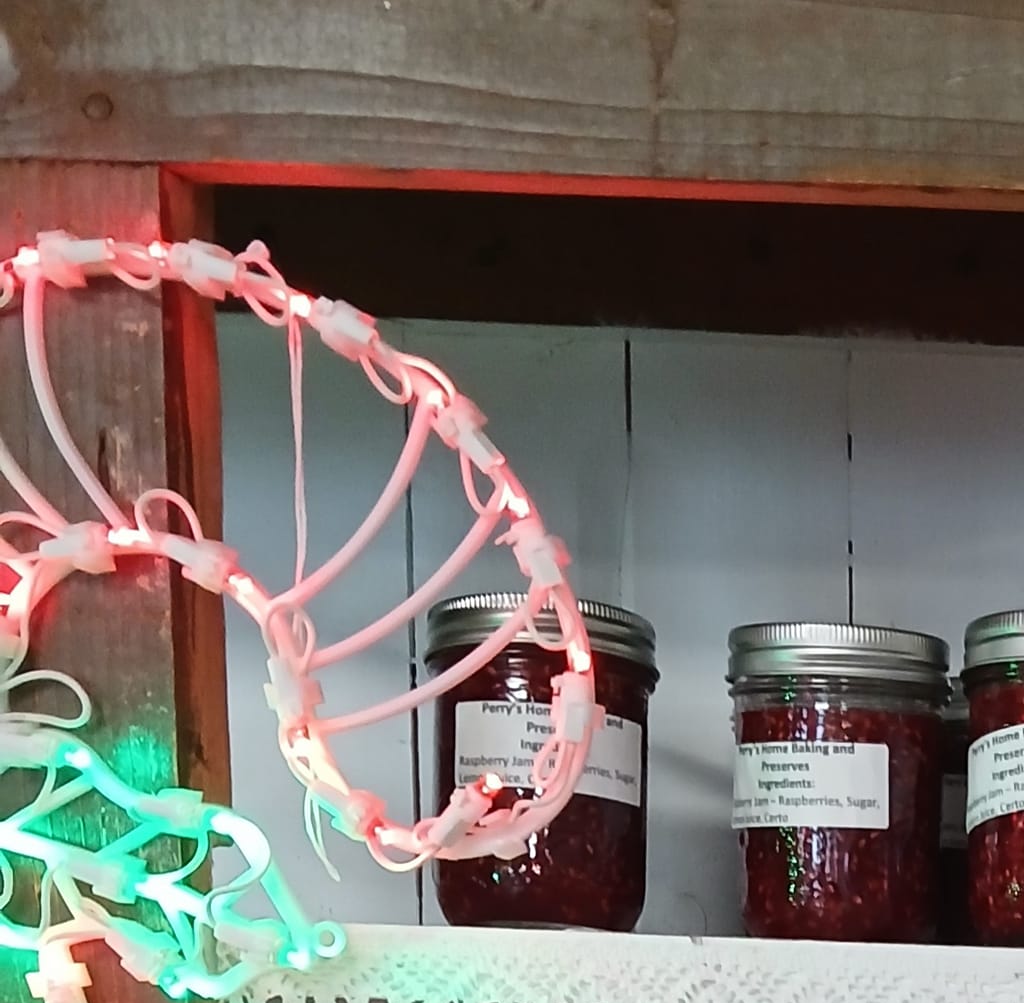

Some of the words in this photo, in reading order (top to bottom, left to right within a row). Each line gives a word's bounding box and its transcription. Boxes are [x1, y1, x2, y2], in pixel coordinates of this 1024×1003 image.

[482, 703, 522, 716] Perry's
[526, 703, 552, 716] Hom
[606, 717, 624, 730] and
[992, 731, 1020, 746] Home
[762, 744, 788, 754] Home
[791, 743, 830, 756] Baking
[833, 743, 856, 755] and
[459, 755, 510, 768] Raspberry
[512, 756, 535, 767] Jam
[762, 761, 810, 772] Preserves
[758, 778, 816, 791] Ingredients:
[778, 795, 844, 808] Raspberries,
[847, 796, 881, 810] Sugar,
[763, 812, 789, 823] Certo
